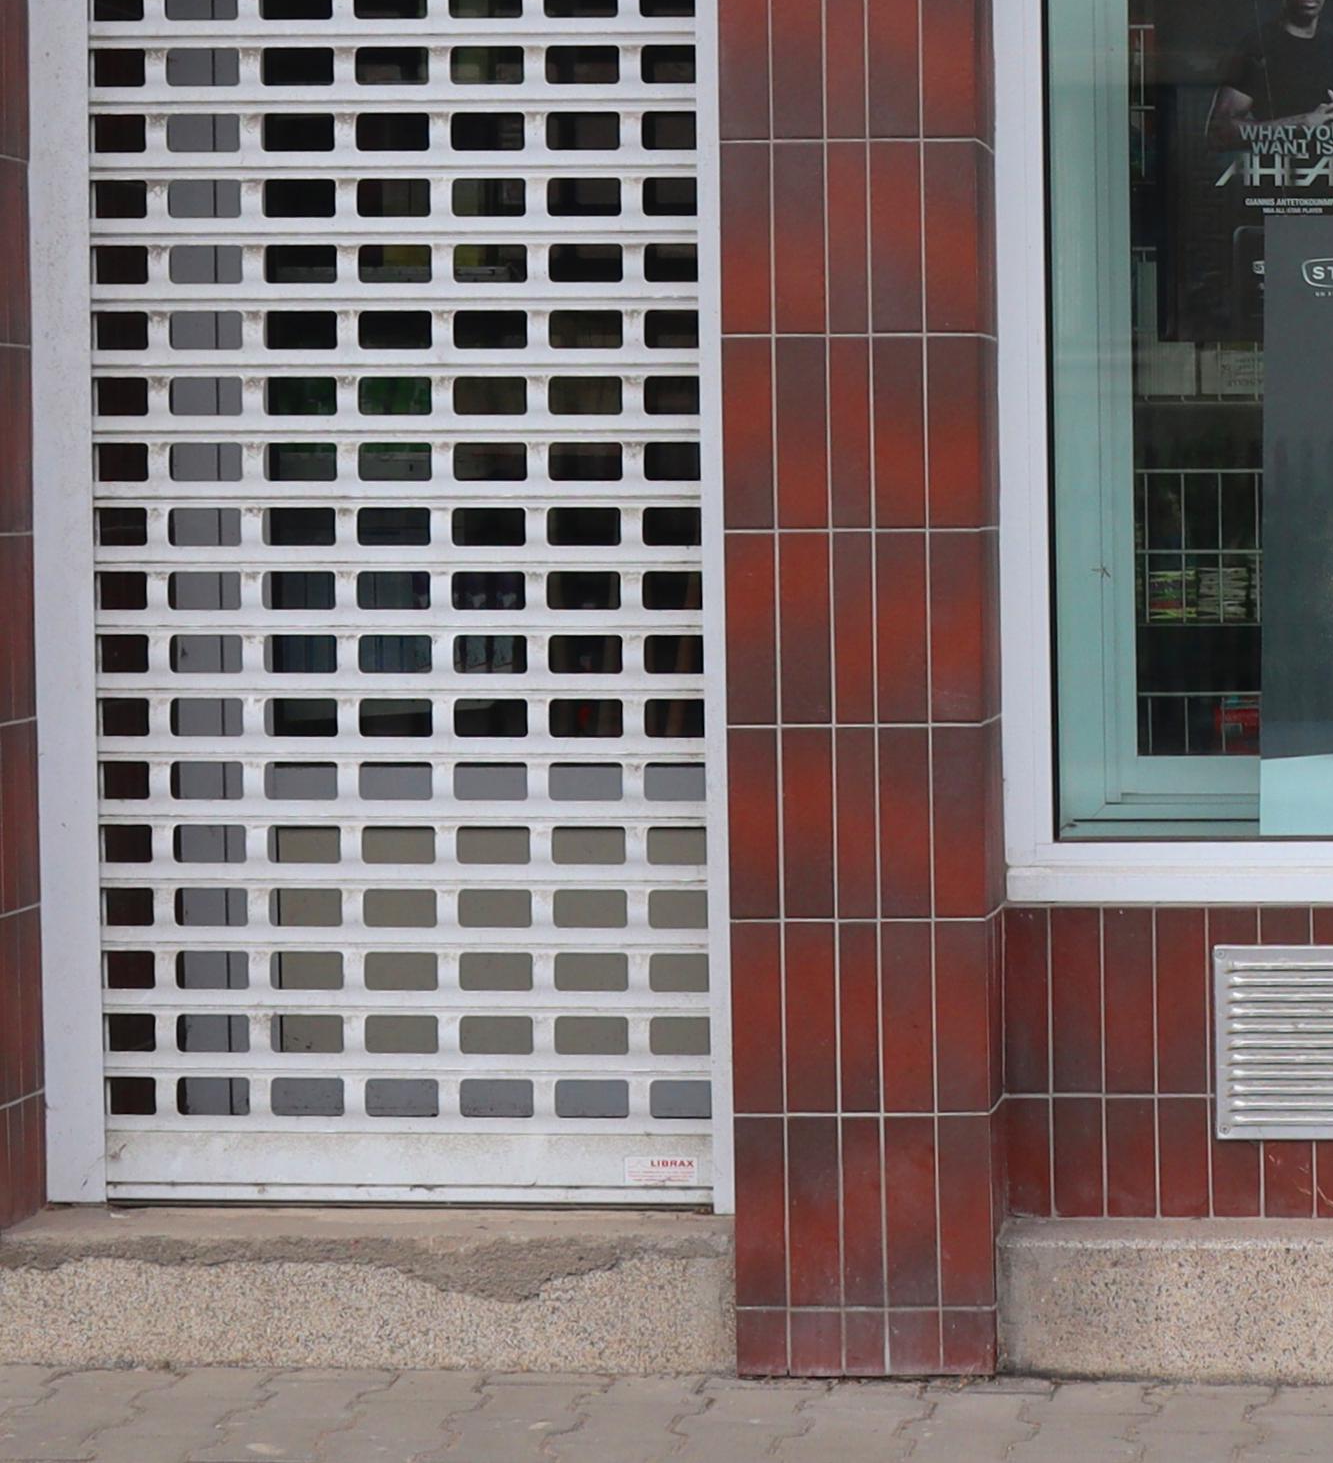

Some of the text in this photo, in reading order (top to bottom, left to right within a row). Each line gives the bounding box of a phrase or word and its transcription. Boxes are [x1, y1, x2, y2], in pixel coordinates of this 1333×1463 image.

[1239, 125, 1297, 141] WHAT
[1252, 139, 1308, 155] WANT
[650, 1159, 695, 1168] LIBRAX
